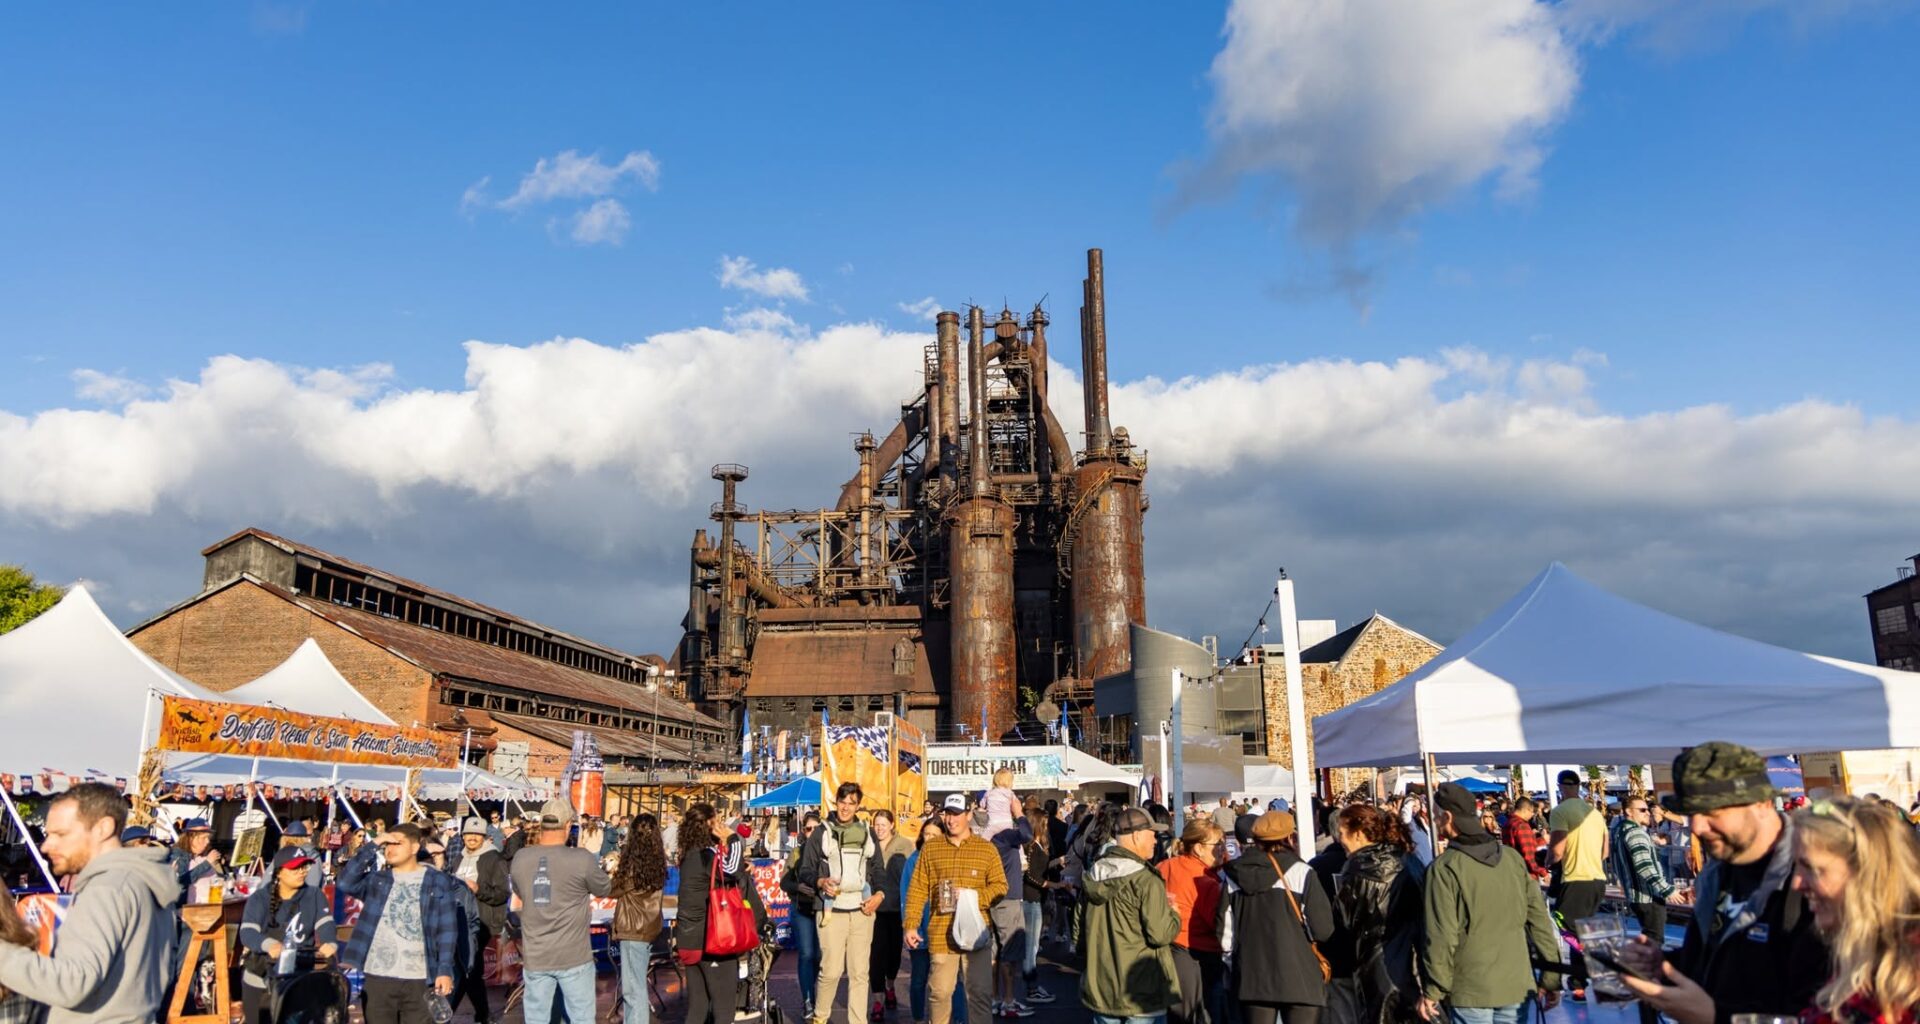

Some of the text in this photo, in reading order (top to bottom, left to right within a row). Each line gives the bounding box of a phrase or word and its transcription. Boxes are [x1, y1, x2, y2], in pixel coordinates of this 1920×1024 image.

[220, 714, 276, 742] Dogfish
[314, 728, 323, 745] &
[325, 728, 349, 749] Sam
